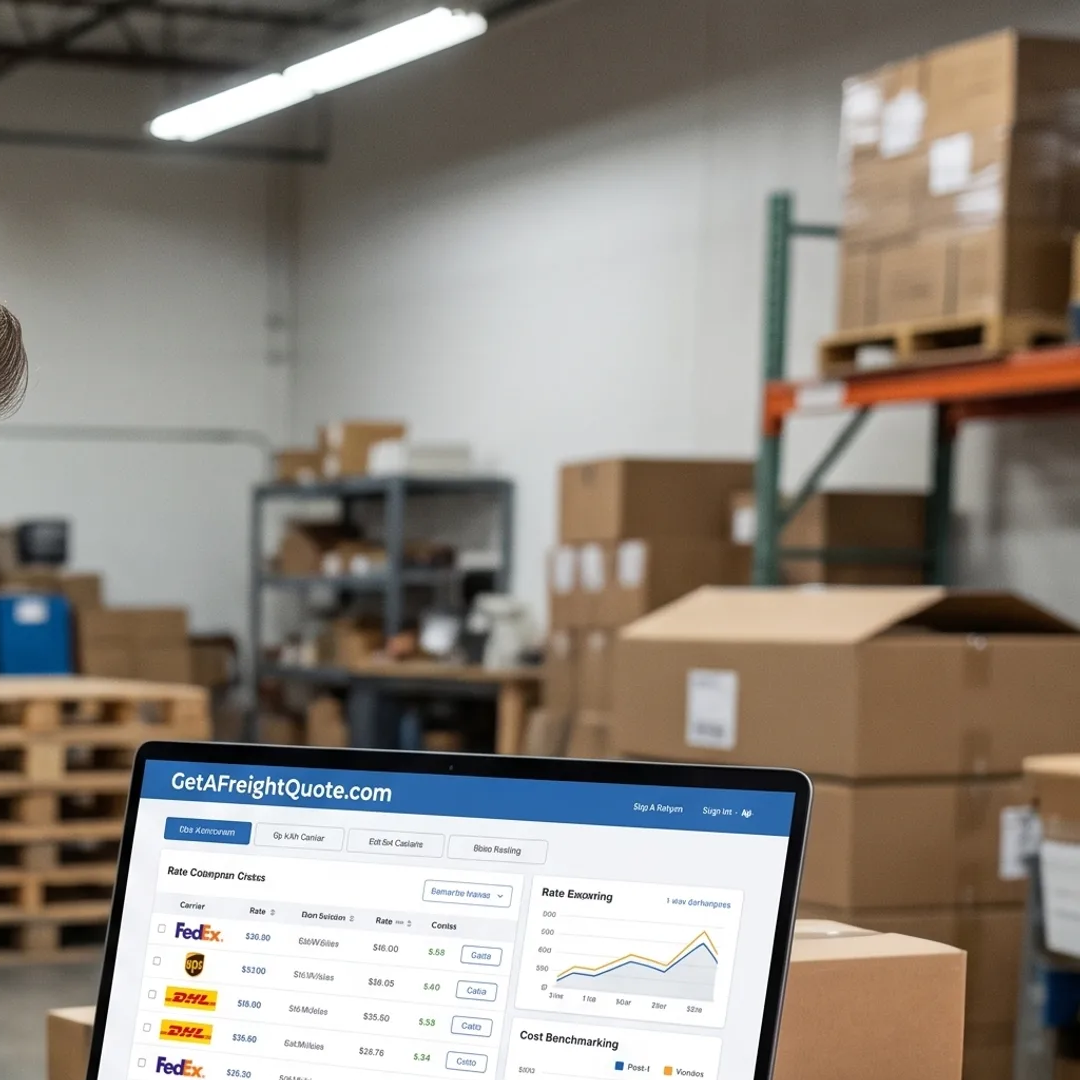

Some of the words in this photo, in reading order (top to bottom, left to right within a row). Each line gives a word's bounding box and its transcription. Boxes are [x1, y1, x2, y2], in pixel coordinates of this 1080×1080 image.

[171, 772, 392, 802] GetAFreightQuote.com
[168, 866, 188, 877] Rate
[542, 888, 565, 898] Rate
[180, 901, 205, 910] Carrier
[249, 907, 266, 915] Rate
[376, 917, 393, 925] Rate
[172, 992, 209, 1006] DHL
[167, 1025, 205, 1039] DHL
[520, 1030, 543, 1042] Cost
[546, 1033, 619, 1051] Benchmarking
